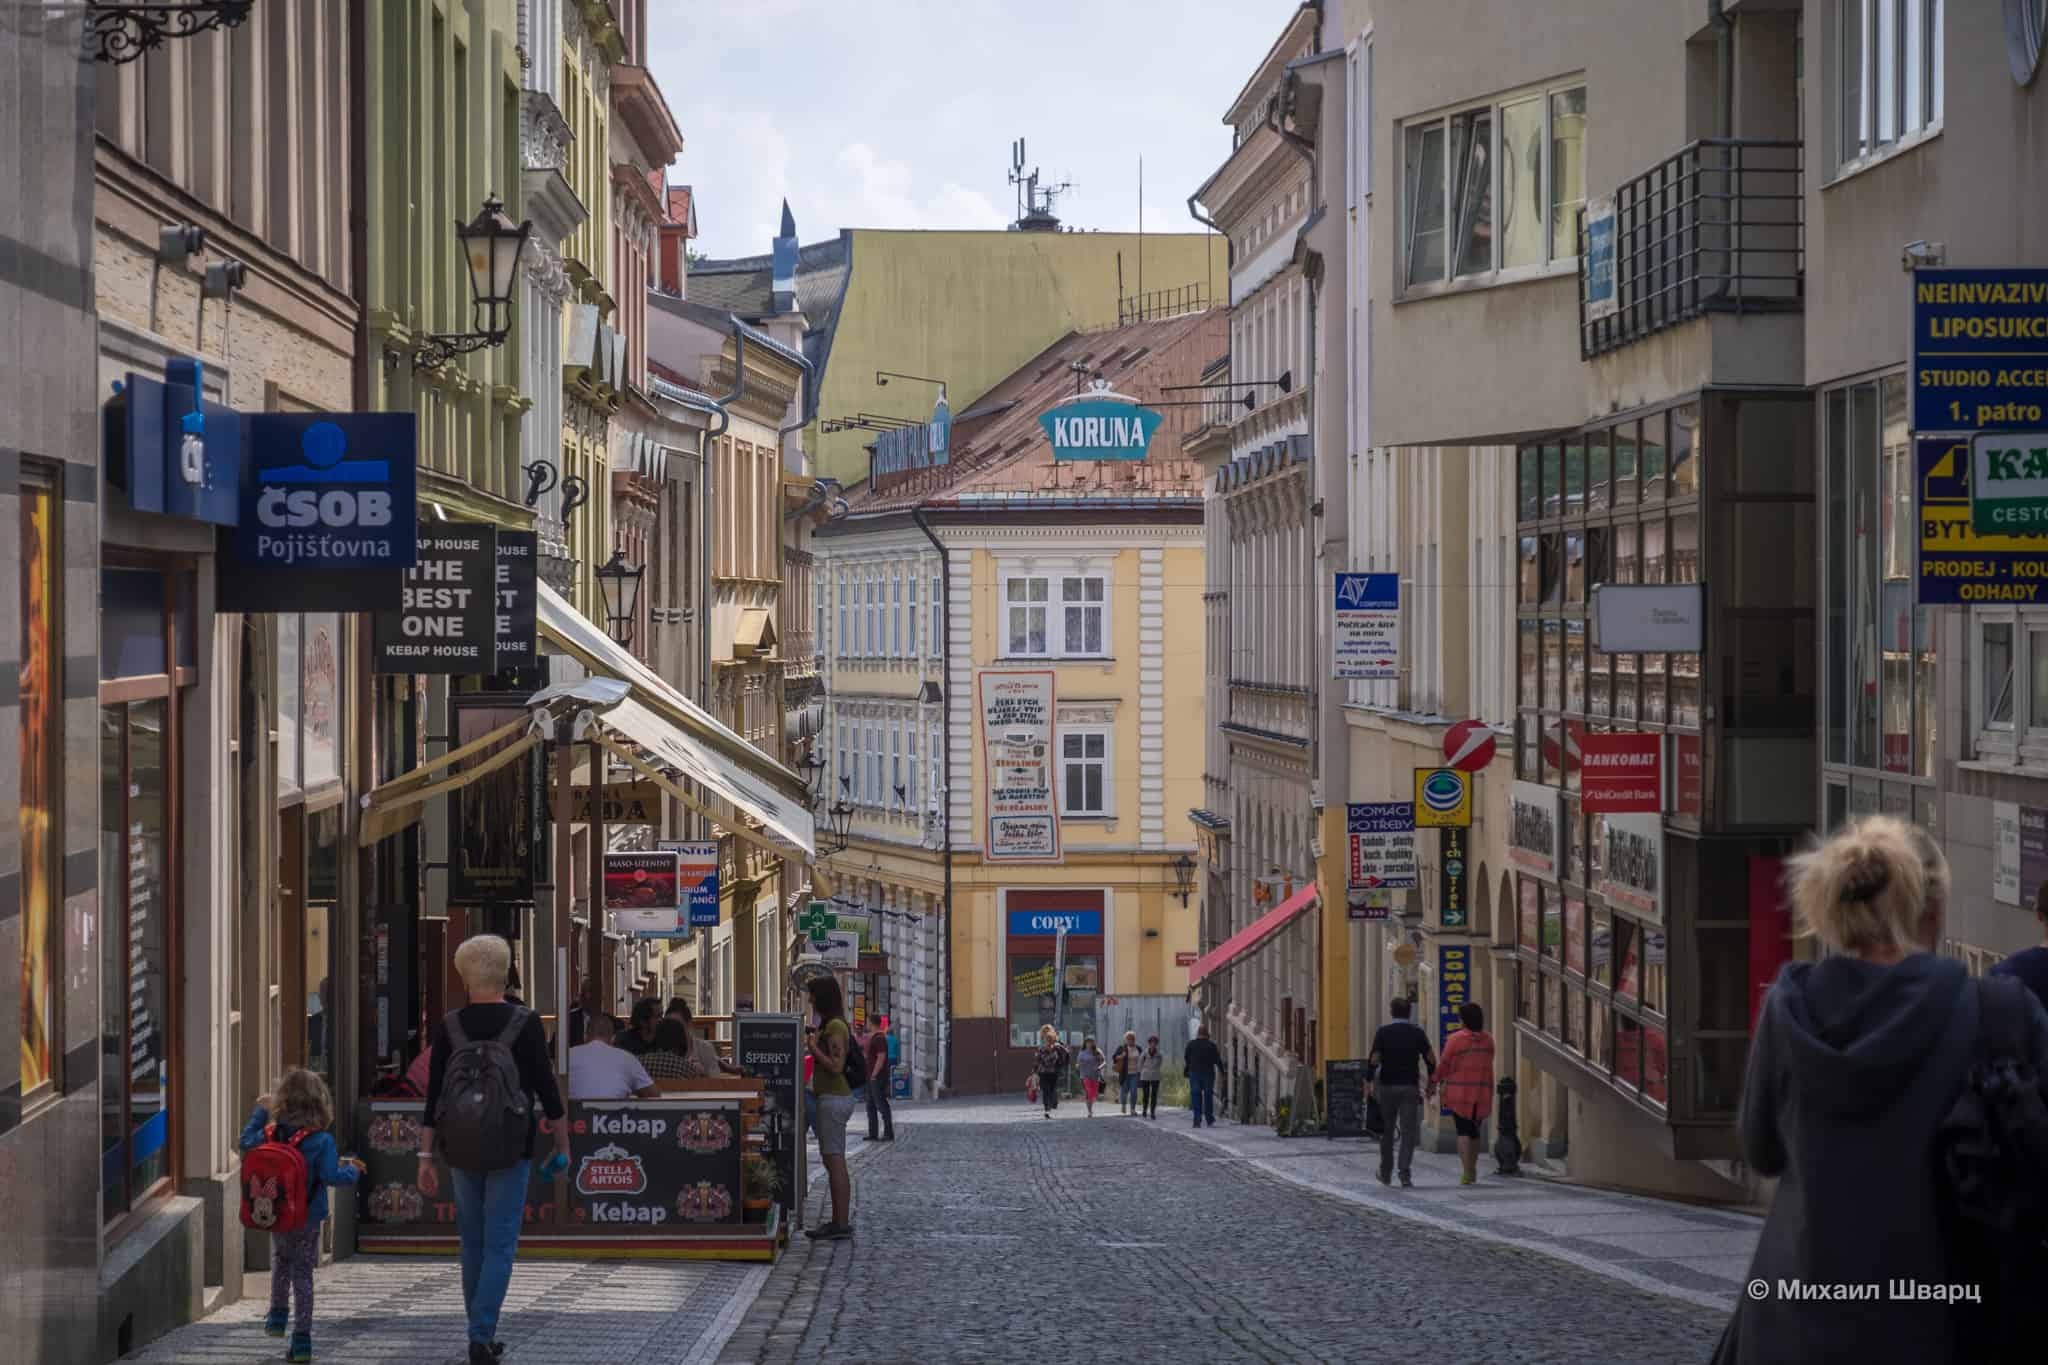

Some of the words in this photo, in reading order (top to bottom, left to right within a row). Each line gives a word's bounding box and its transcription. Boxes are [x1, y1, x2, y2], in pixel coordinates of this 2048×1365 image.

[1918, 283, 2048, 303] NEINVAZIV
[1930, 318, 2048, 338] LIPOSUKC
[1919, 370, 1991, 386] STUDIO
[1995, 370, 2048, 386] ACCE
[1950, 401, 1969, 421] 1.
[1977, 402, 2041, 426] patro
[1054, 418, 1146, 448] KORUNA
[256, 486, 392, 528] ČSOB
[258, 534, 391, 566] Pojišťovna
[435, 539, 480, 550] HOUSE
[496, 546, 528, 555] OUSE
[409, 560, 463, 581] THE
[1922, 561, 1995, 577] PRODEJ
[402, 588, 472, 608] BEST
[1959, 583, 2038, 600] ODHADY
[402, 616, 464, 637] ONE
[386, 646, 429, 657] KEBAP
[433, 646, 478, 656] HOUSE
[496, 642, 528, 651] OUSE
[1583, 754, 1656, 766] BANKOMAT
[1594, 791, 1634, 800] UniCredit
[1635, 790, 1656, 799] Bank
[1351, 804, 1410, 817] DOMÁCÍ
[1350, 819, 1412, 831] POTŘEBY
[745, 1050, 791, 1064] ŠPERKY
[592, 1114, 667, 1138] Kebap
[591, 1166, 632, 1175] STELLA
[590, 1175, 633, 1185] ARTOIS
[592, 1202, 667, 1225] Kebap
